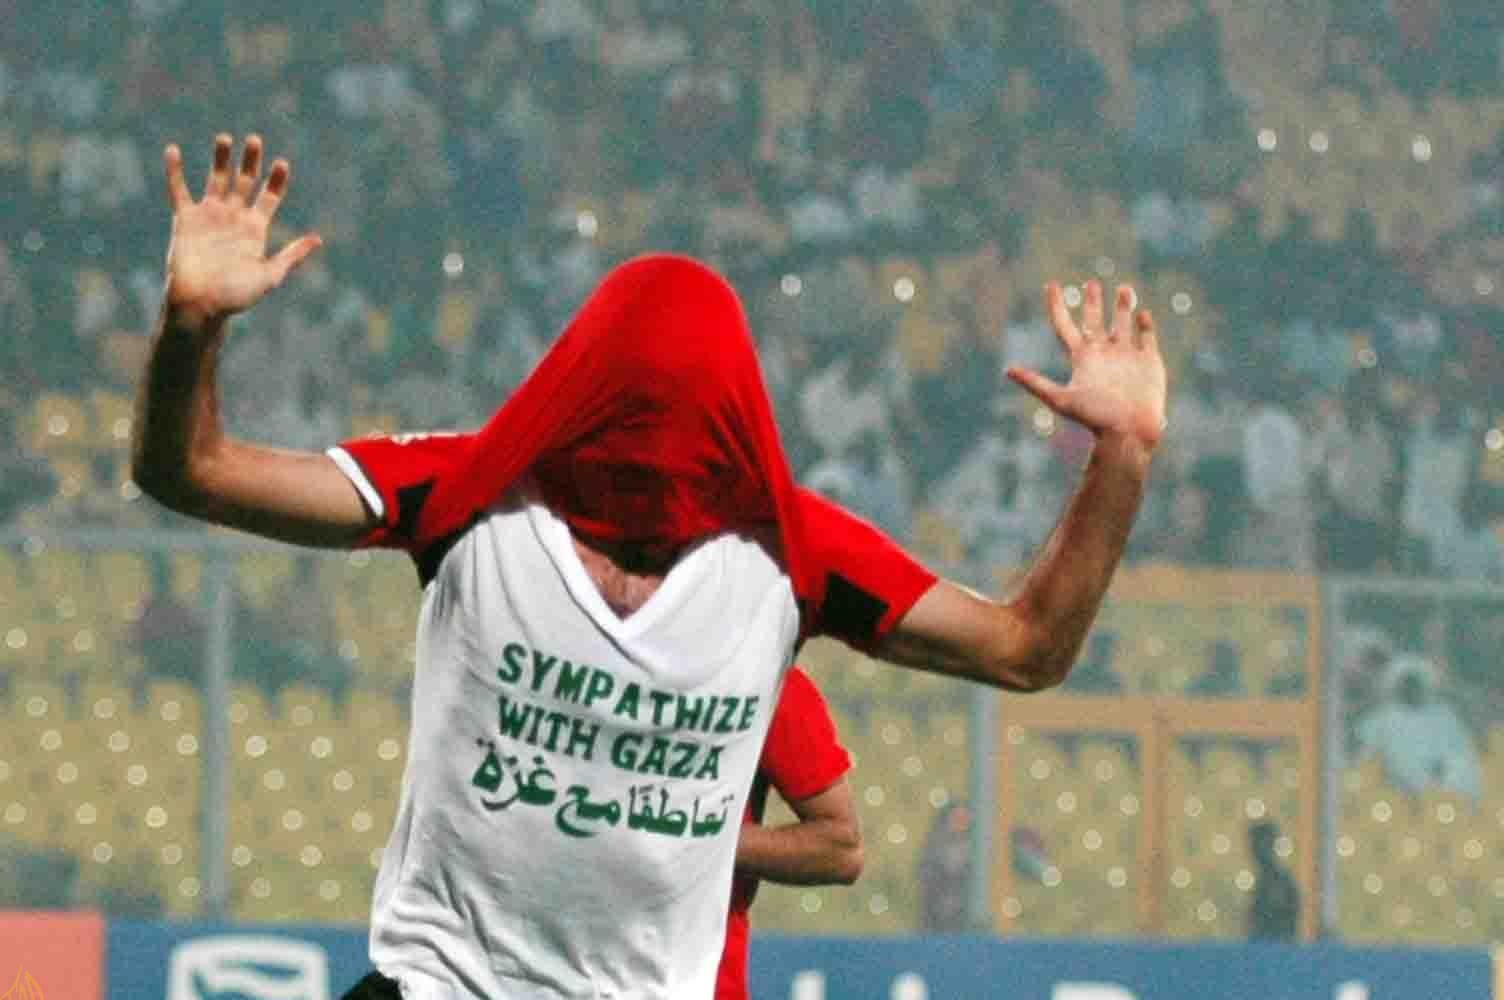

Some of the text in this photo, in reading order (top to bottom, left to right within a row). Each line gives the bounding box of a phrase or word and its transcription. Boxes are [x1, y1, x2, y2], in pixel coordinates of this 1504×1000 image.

[497, 642, 760, 734] SYMPATHIZE
[471, 737, 558, 812] غزة
[497, 695, 726, 781] WITH GAZA
[554, 784, 622, 838] مع
